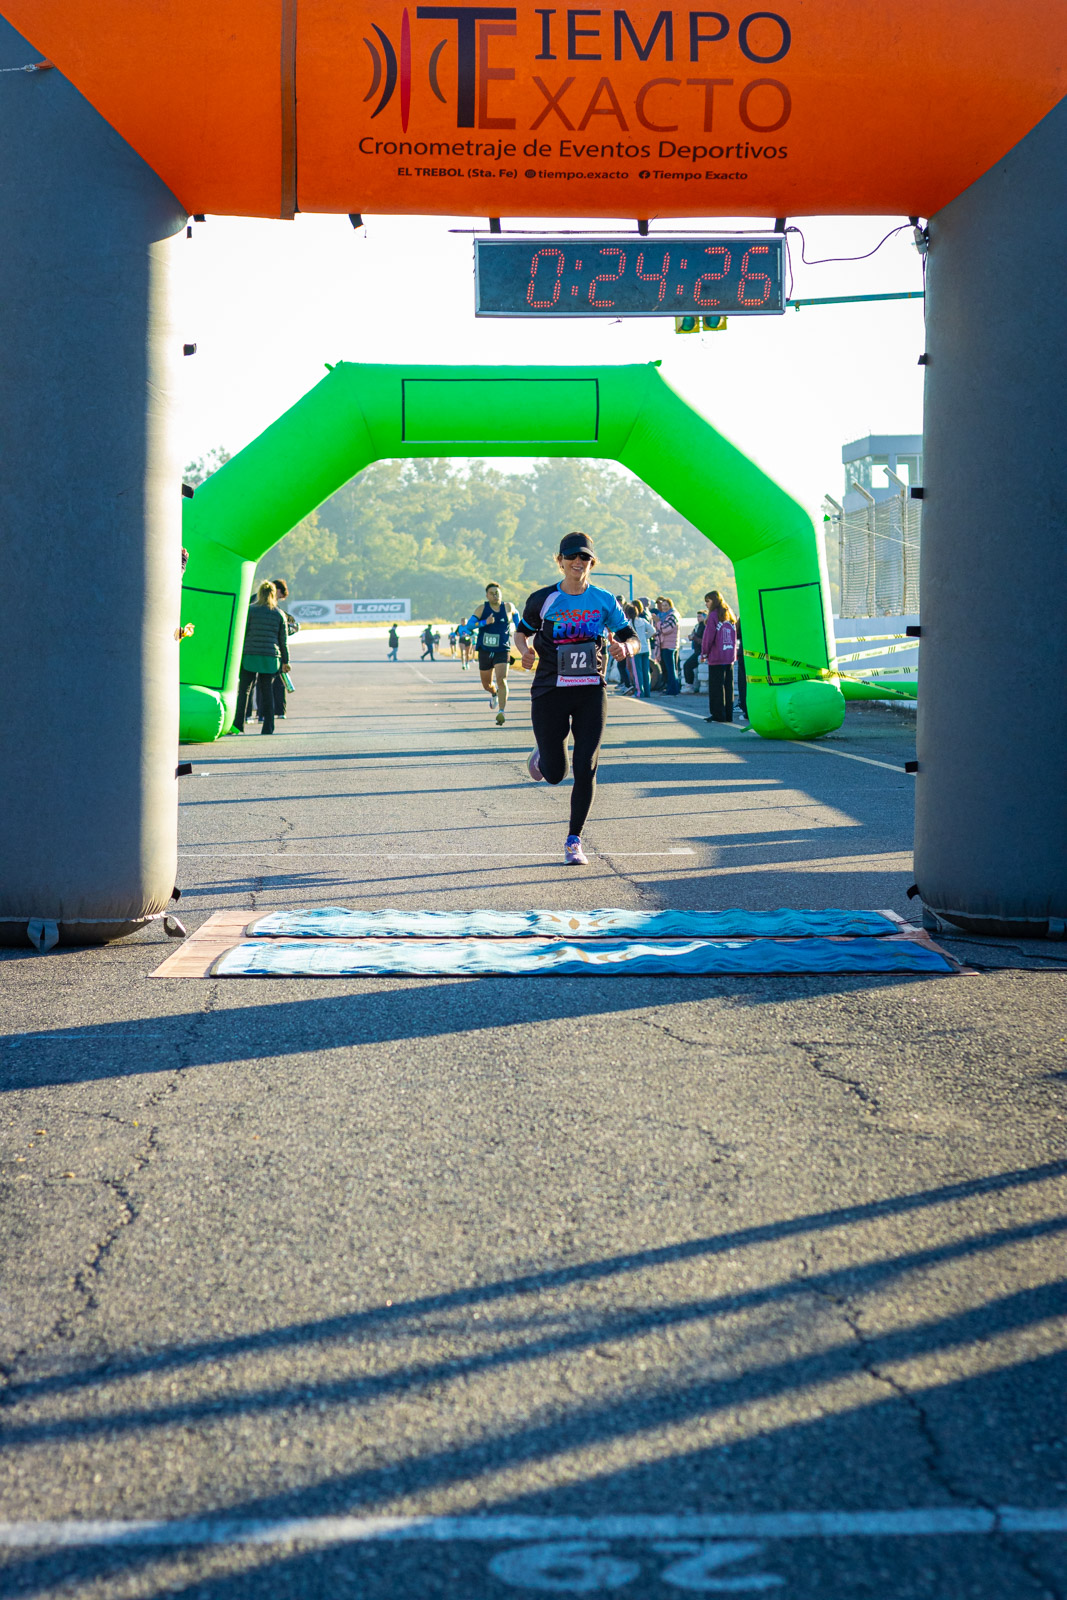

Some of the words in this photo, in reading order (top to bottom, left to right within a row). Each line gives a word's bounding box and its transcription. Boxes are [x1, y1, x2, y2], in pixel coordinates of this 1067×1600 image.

[358, 136, 517, 160] Cronometraje
[522, 139, 552, 157] de
[559, 140, 651, 158] Eventos
[657, 140, 788, 162] Deportivos
[397, 167, 412, 176] EL
[413, 168, 464, 177] TREBOL
[467, 167, 497, 179] (Sta.
[499, 169, 518, 179] Fe)
[537, 169, 629, 181] tiempo.exacto
[653, 170, 702, 182] Tiempo
[705, 170, 749, 181] Exacto
[526, 246, 772, 308] 0:24:26
[298, 606, 323, 616] Ford
[356, 604, 402, 613] LONG
[570, 651, 587, 669] 72
